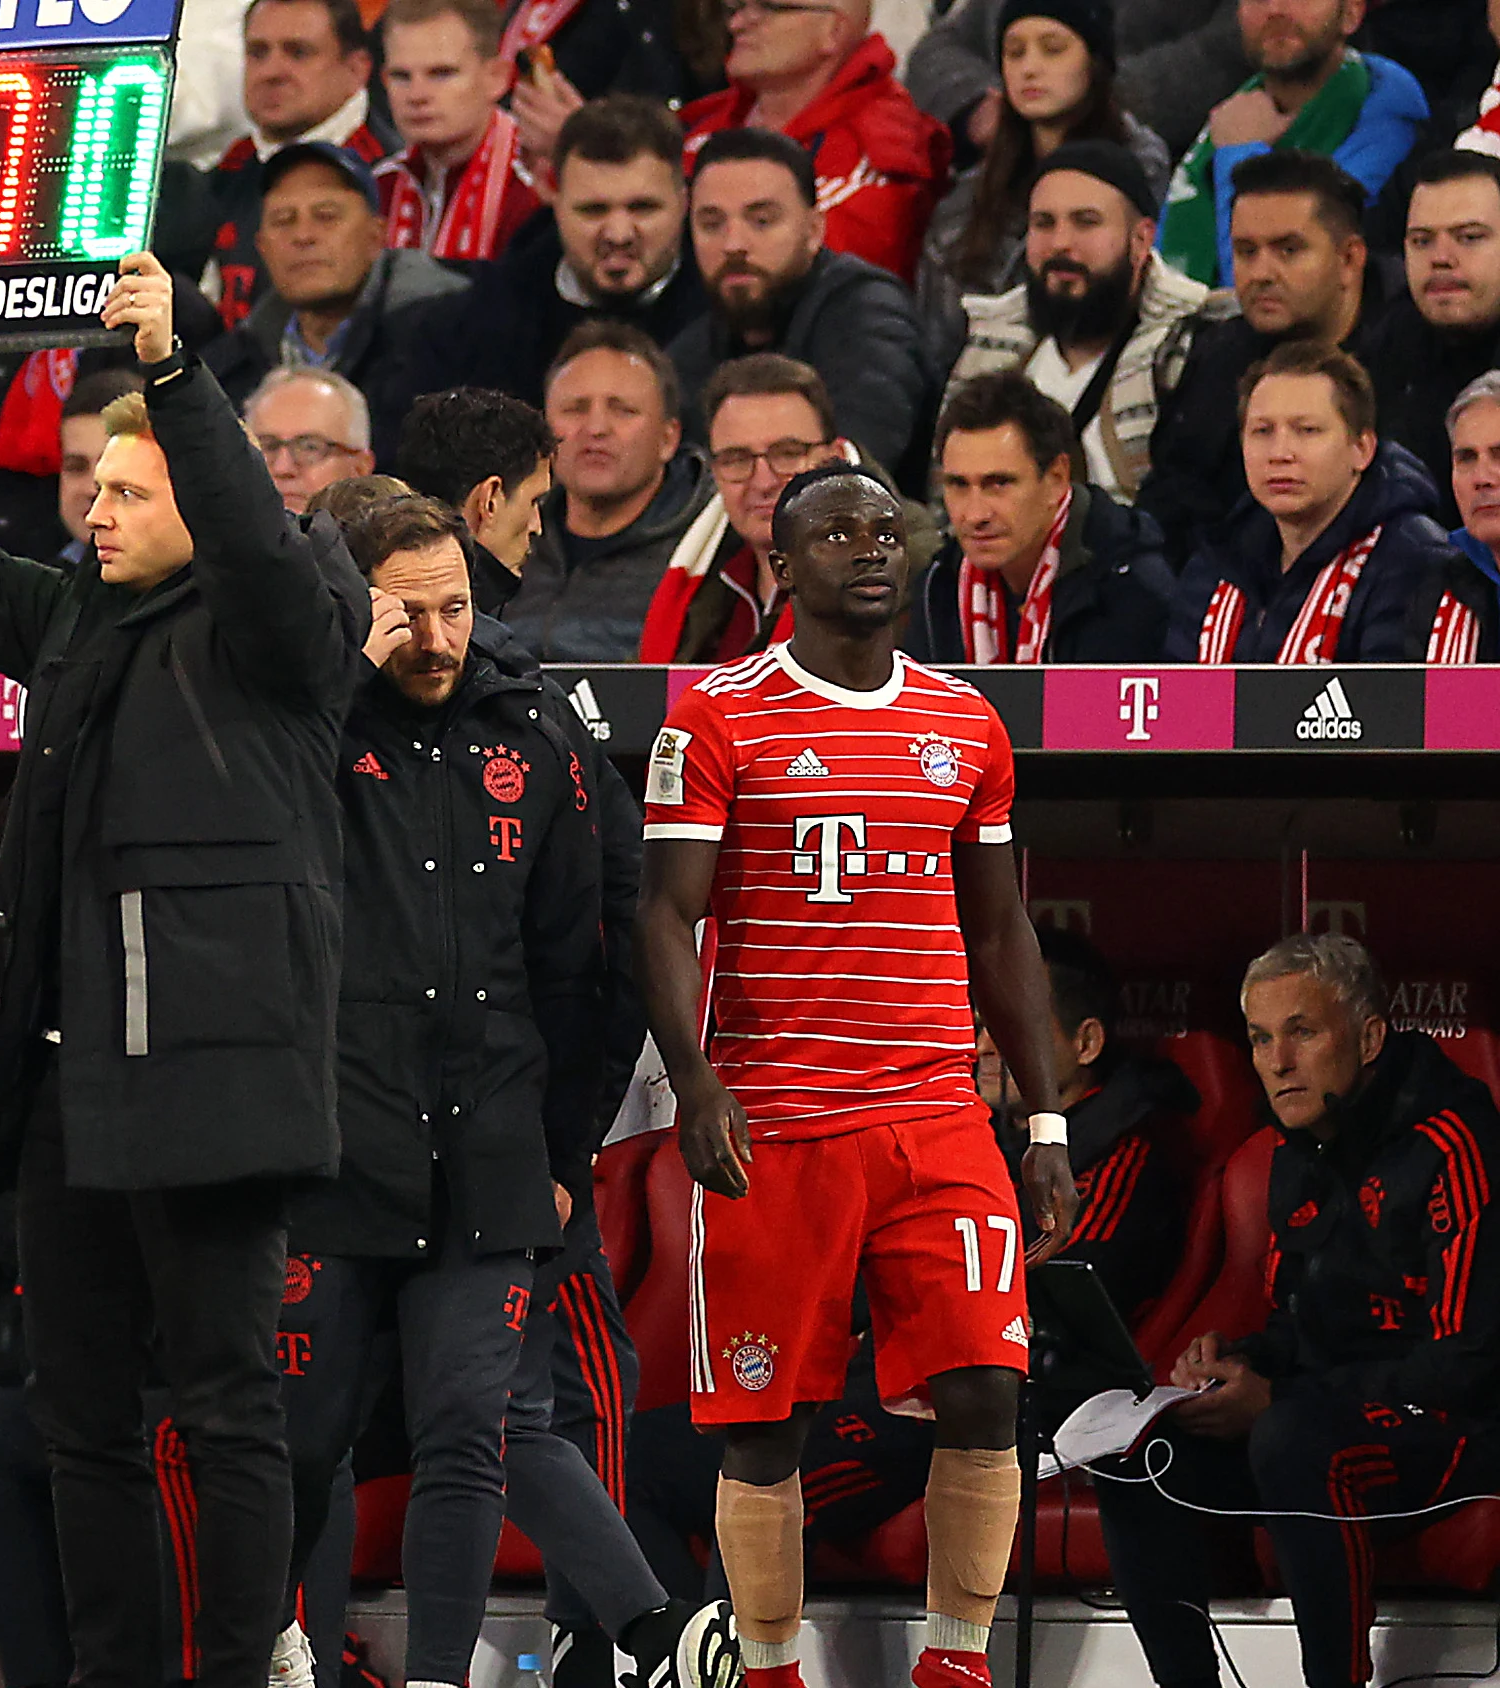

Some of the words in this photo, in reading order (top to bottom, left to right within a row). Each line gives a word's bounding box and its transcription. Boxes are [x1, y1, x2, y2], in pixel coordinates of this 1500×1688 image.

[1119, 678, 1159, 740] T
[1296, 716, 1362, 739] adidas
[786, 766, 829, 777] adidas
[1117, 981, 1191, 1015] ATAR
[1389, 981, 1469, 1015] ATAR
[955, 1215, 1016, 1293] 17
